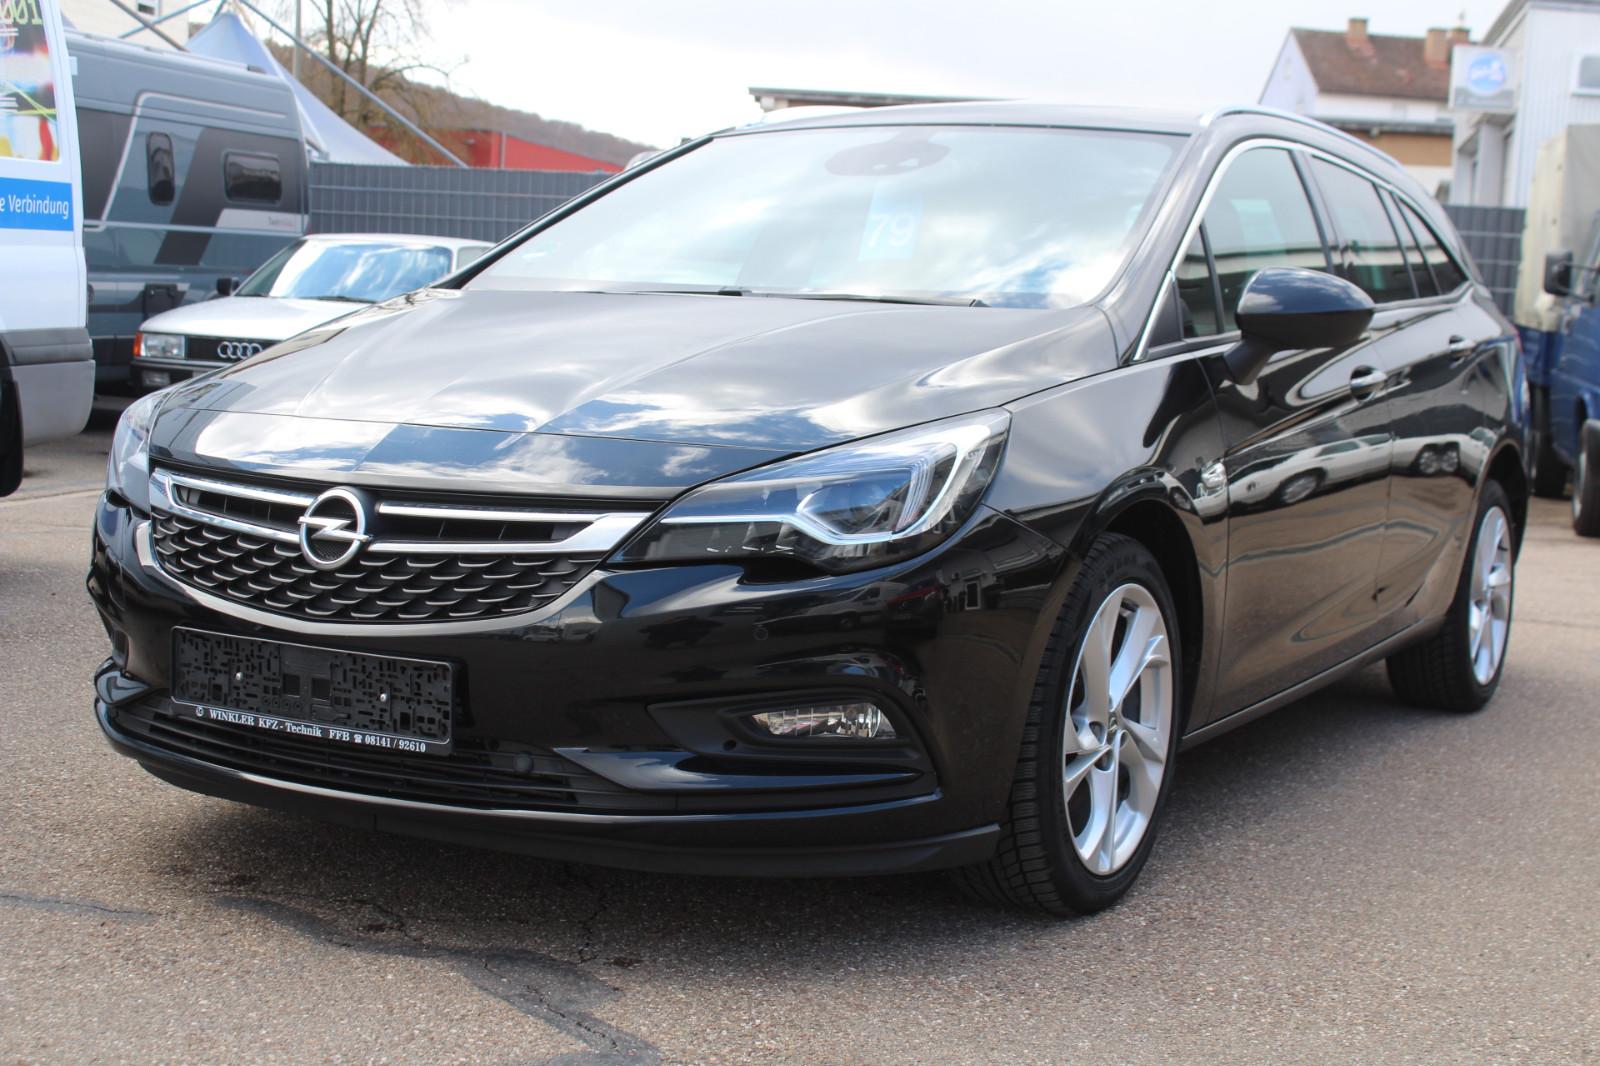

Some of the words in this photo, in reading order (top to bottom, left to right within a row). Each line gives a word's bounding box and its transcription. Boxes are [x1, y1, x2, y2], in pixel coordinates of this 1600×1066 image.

[8, 194, 69, 220] Verbindung
[209, 709, 254, 726] WINKLER
[329, 729, 350, 741] FFB
